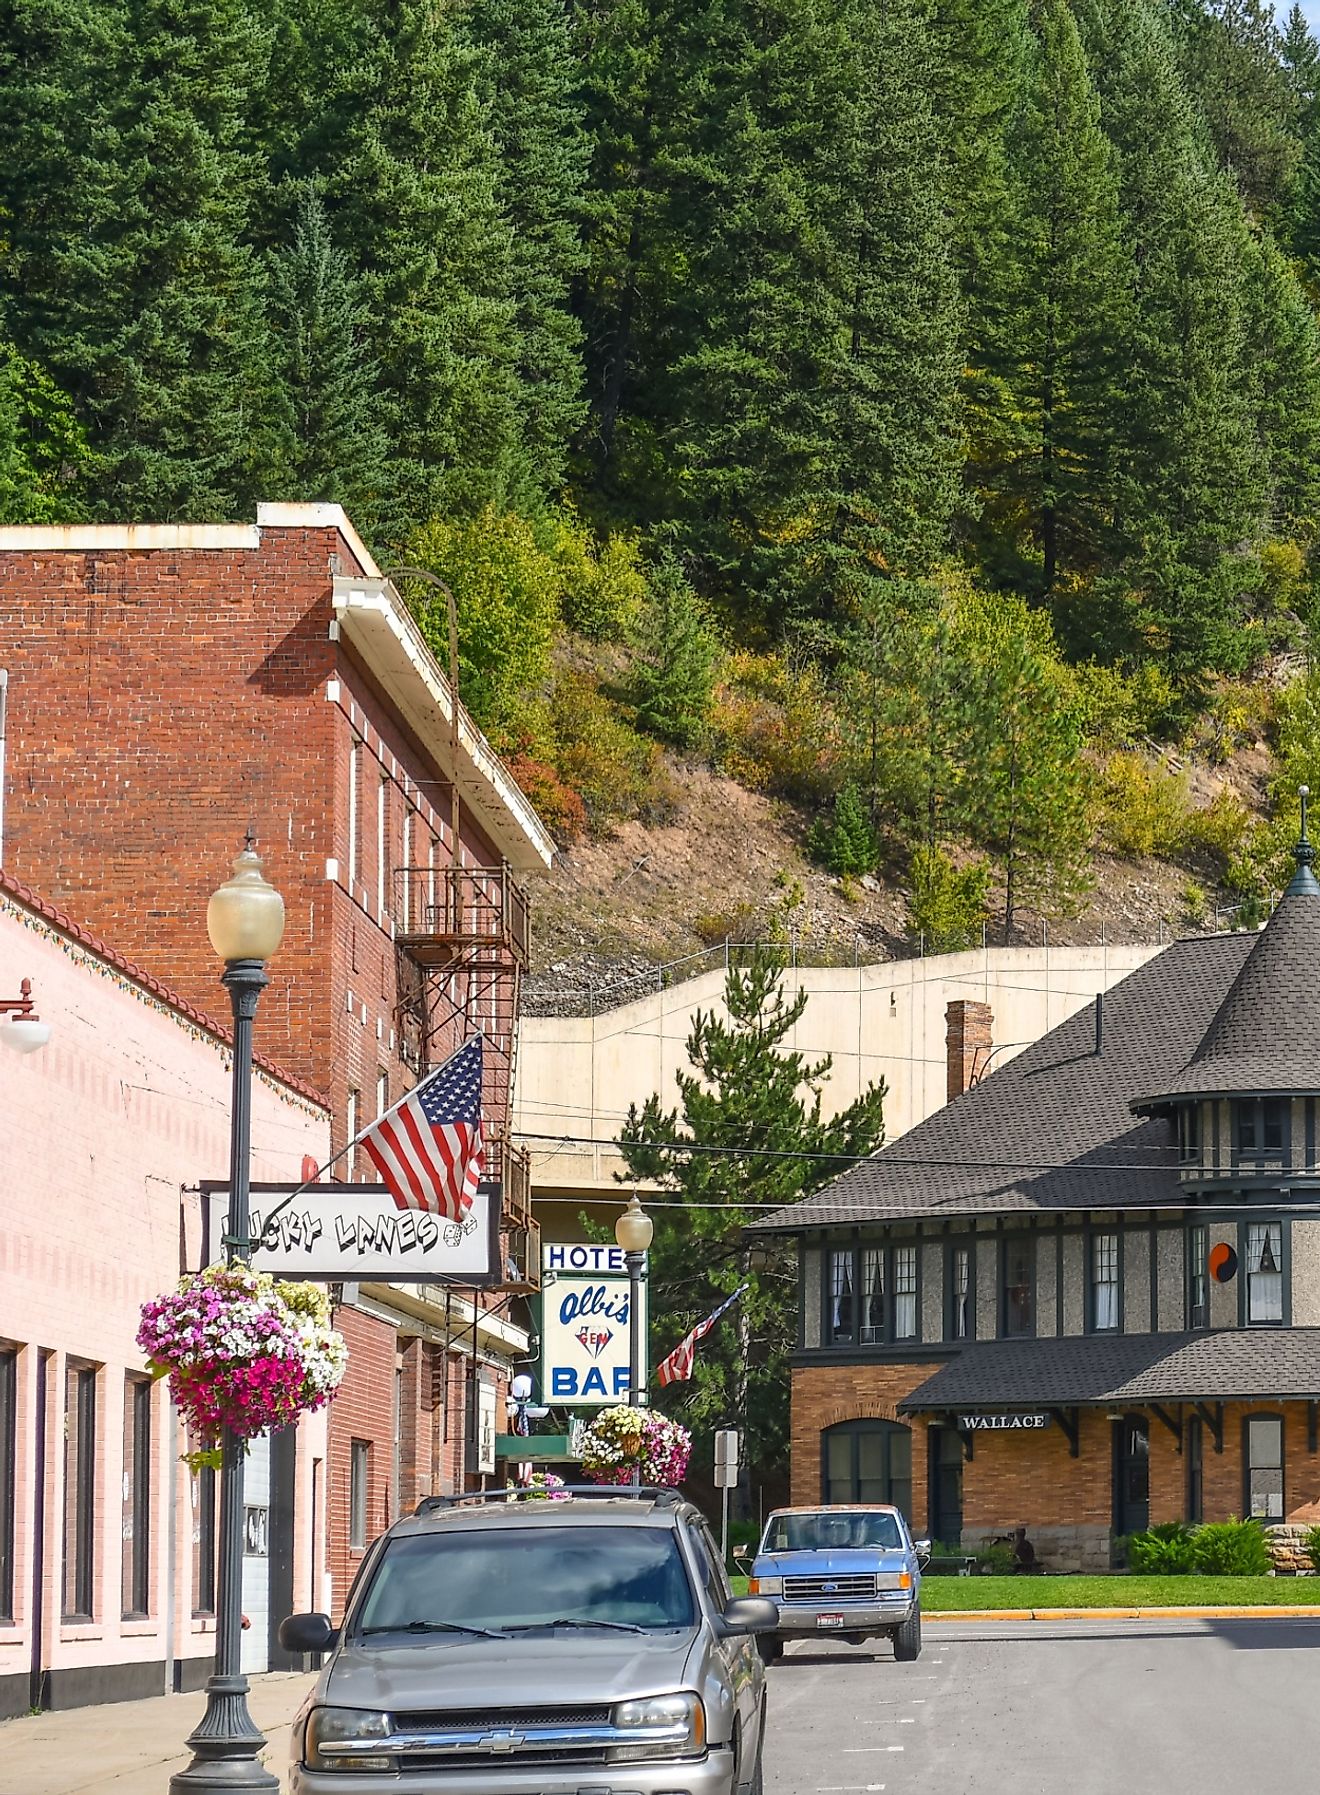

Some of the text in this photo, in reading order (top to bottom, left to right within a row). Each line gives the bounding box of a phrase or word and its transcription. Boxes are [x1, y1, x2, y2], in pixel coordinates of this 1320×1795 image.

[334, 1211, 438, 1255] LANES
[549, 1246, 623, 1270] HOTE
[579, 1332, 609, 1345] GEM
[963, 1415, 1044, 1429] WALLACE
